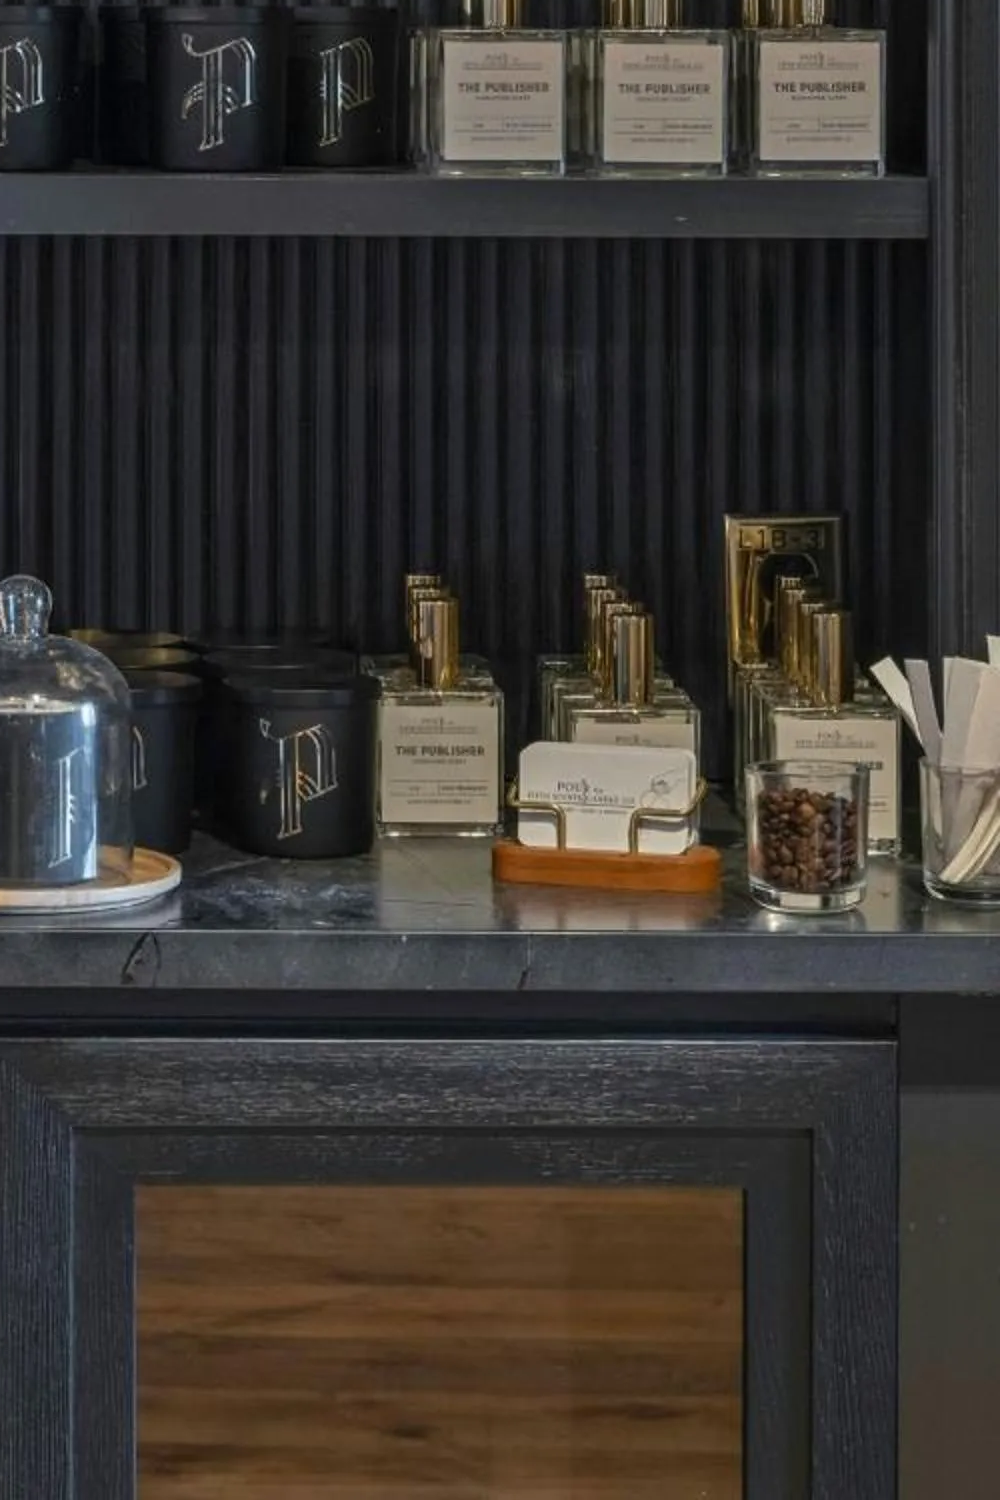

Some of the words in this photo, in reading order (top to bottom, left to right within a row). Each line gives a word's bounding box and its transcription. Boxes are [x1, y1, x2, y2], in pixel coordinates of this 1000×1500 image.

[459, 82, 480, 92] THE
[485, 82, 549, 93] PUBLISHER
[619, 83, 640, 93] THE
[645, 83, 710, 94] PUBLISHER
[774, 81, 796, 92] THE
[800, 81, 865, 92] PUBLISHER
[395, 745, 417, 756] THE
[421, 745, 485, 756] PUBLISHER
